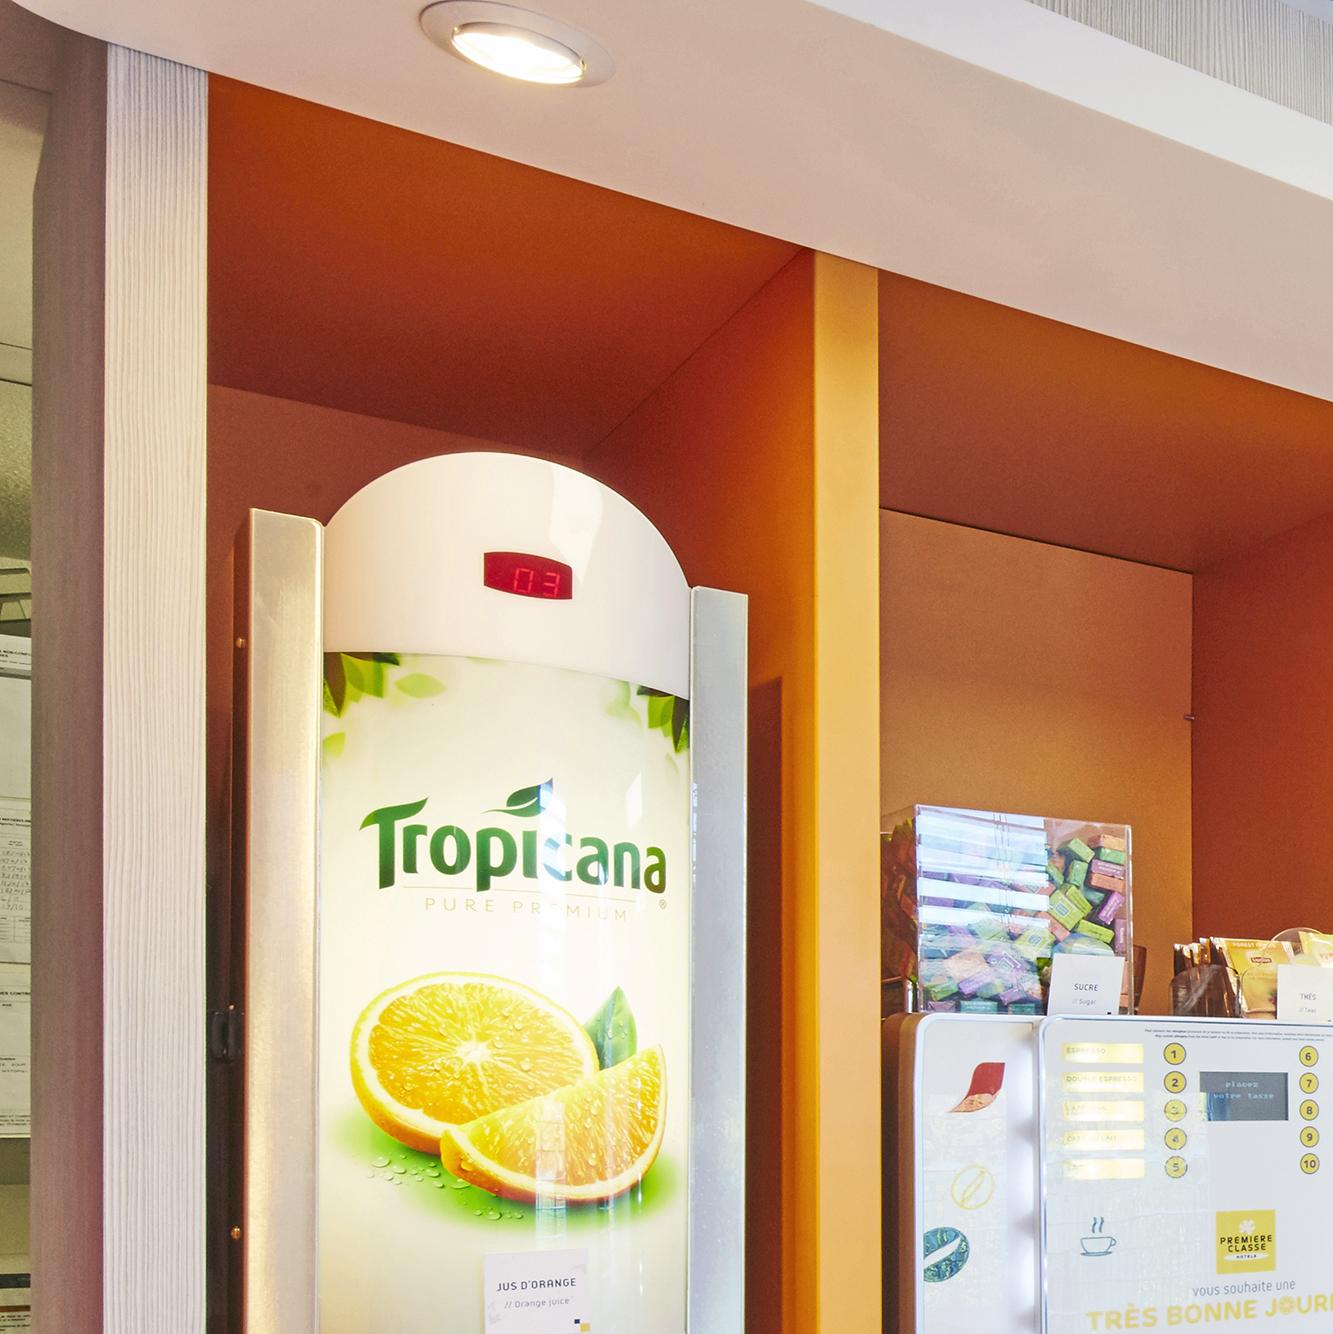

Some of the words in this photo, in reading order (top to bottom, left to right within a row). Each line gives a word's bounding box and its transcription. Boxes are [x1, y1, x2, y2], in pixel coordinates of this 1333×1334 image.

[513, 567, 560, 597] 03
[359, 796, 666, 894] Tropicana
[425, 896, 496, 913] PURE
[512, 900, 627, 921] PRMIUM
[1073, 983, 1098, 991] SUCRE
[1170, 1050, 1177, 1059] 1
[1305, 1052, 1312, 1061] 6
[1171, 1078, 1179, 1087] 2
[1225, 1081, 1259, 1089] placez
[1306, 1079, 1312, 1088] 7
[1306, 1106, 1313, 1115] 8
[1306, 1132, 1313, 1141] 9
[1172, 1163, 1180, 1172] 5
[1303, 1159, 1317, 1169] 10
[1219, 1234, 1272, 1245] PREMIERE
[1227, 1243, 1267, 1252] CLASSE
[497, 1281, 517, 1292] JUS
[520, 1277, 576, 1290] D'ORANGE
[1192, 1285, 1221, 1297] vous
[1223, 1280, 1273, 1296] souhaite
[1275, 1279, 1297, 1291] une
[514, 1300, 547, 1308] Orange
[548, 1298, 570, 1307] juice
[1086, 1303, 1158, 1331] TRÈS
[1166, 1299, 1258, 1326] BONNE
